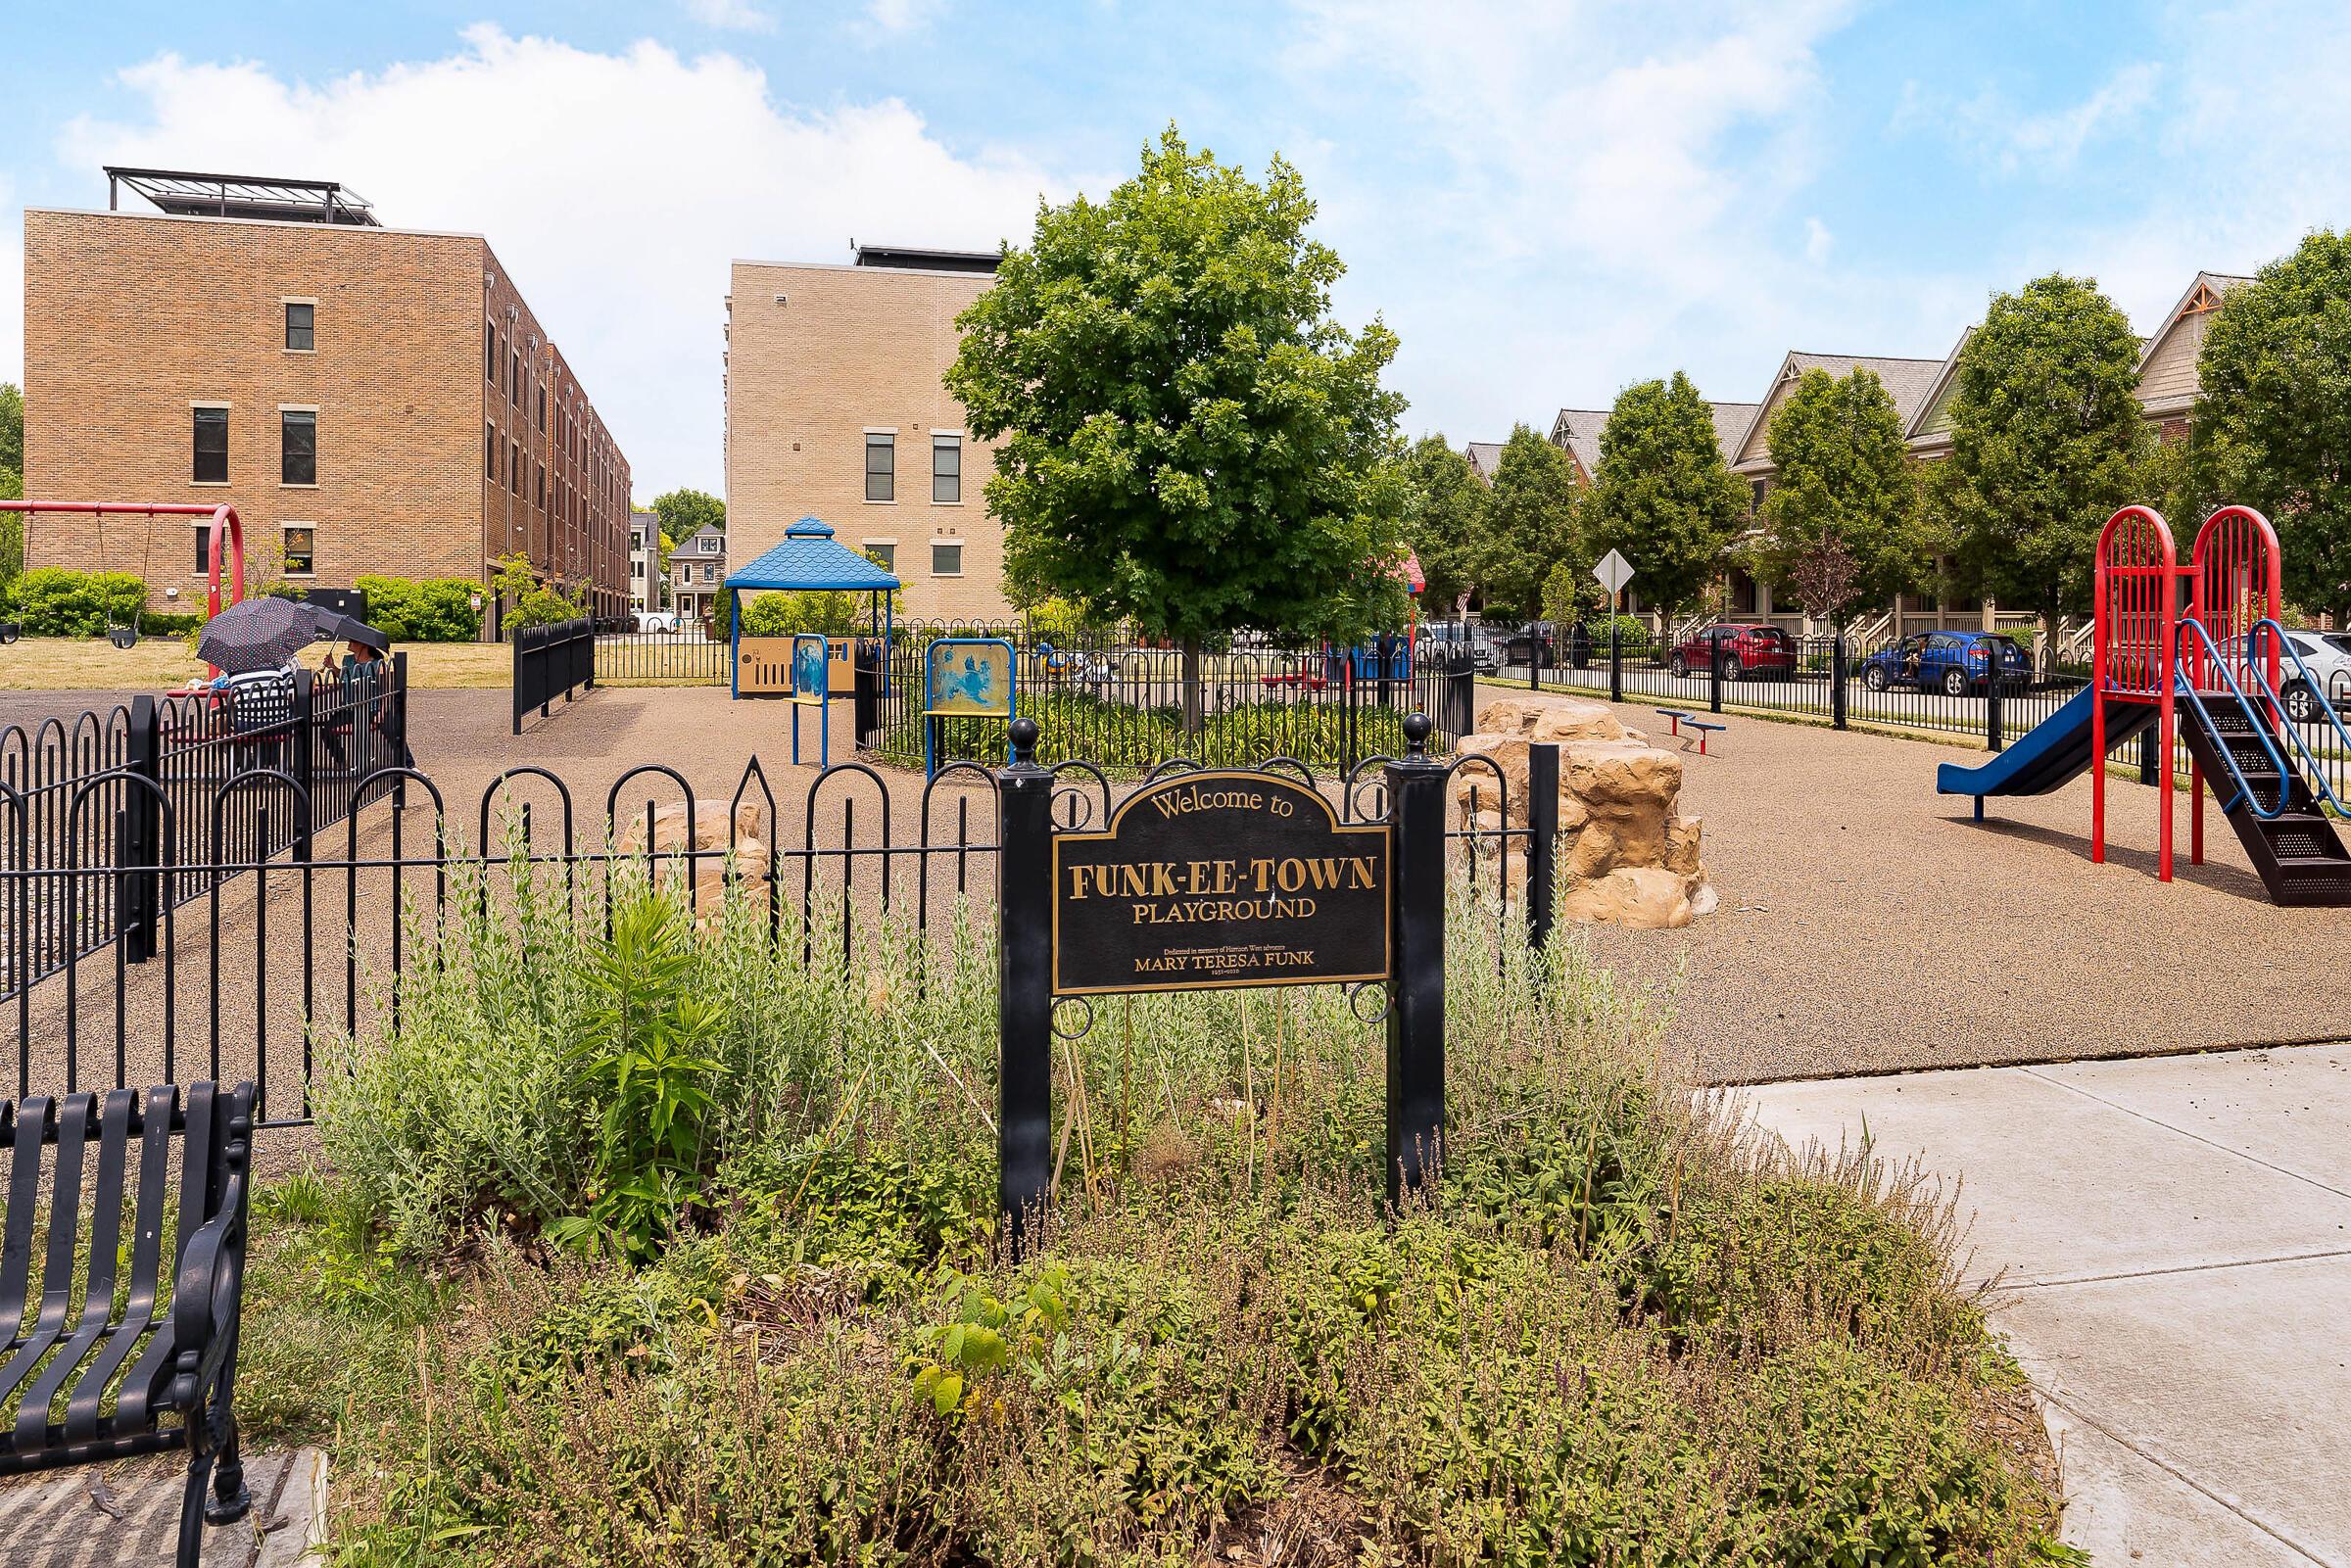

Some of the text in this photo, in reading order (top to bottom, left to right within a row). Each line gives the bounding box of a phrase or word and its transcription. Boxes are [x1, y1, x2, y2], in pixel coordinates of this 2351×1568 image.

[1151, 785, 1293, 820] Welcome to
[1068, 856, 1377, 899] FUNK-EE-TOWN
[1132, 898, 1316, 925] PLAYGROUND
[1134, 951, 1315, 972] MARY TERESA FUNK
[1164, 947, 1190, 956] Dedicated
